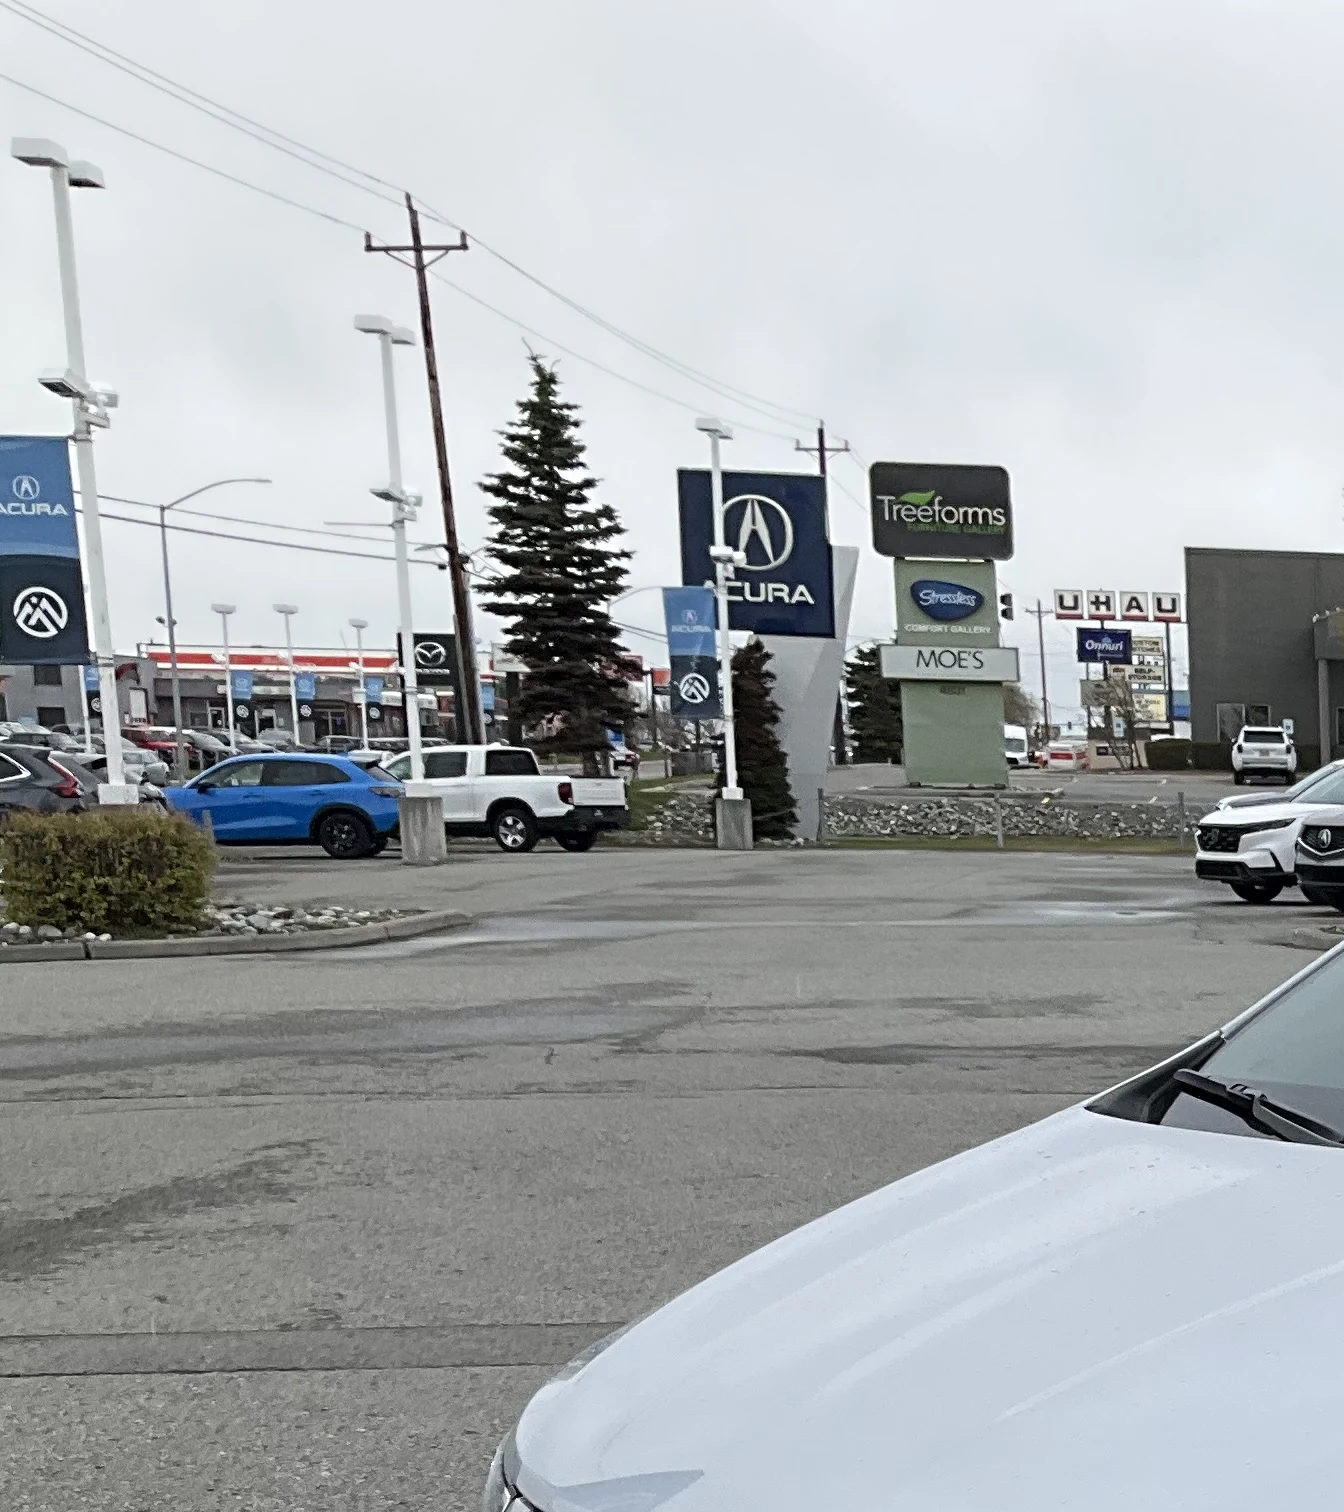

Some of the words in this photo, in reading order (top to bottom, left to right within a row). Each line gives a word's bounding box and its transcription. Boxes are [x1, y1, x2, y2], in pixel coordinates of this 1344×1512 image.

[876, 495, 1006, 525] Treeforms
[919, 589, 977, 607] Stressless
[904, 623, 948, 633] COMFORT
[950, 625, 992, 634] GALLERY
[916, 649, 984, 669] MOE'S
